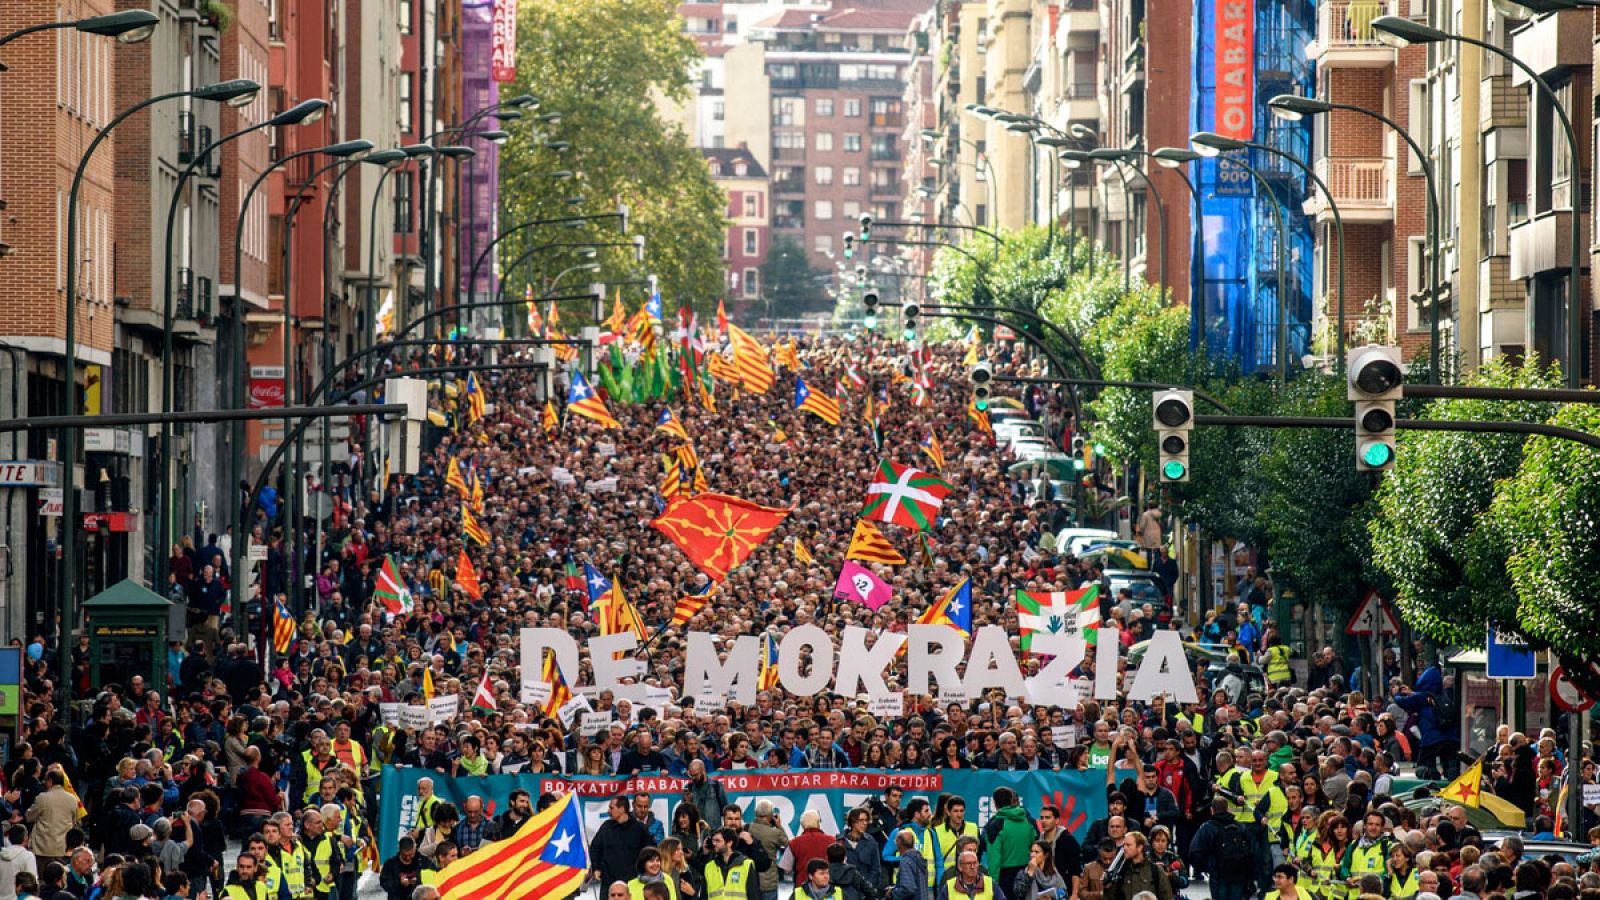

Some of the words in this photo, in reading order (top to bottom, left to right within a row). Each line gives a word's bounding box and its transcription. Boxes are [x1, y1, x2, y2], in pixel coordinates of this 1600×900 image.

[0, 465, 27, 481] TE
[520, 623, 1200, 709] DEMOKRAZIA
[544, 781, 620, 793] BOZKATU
[771, 774, 822, 787] VOTAR
[830, 774, 869, 786] PARA
[877, 776, 938, 788] DECIDIR
